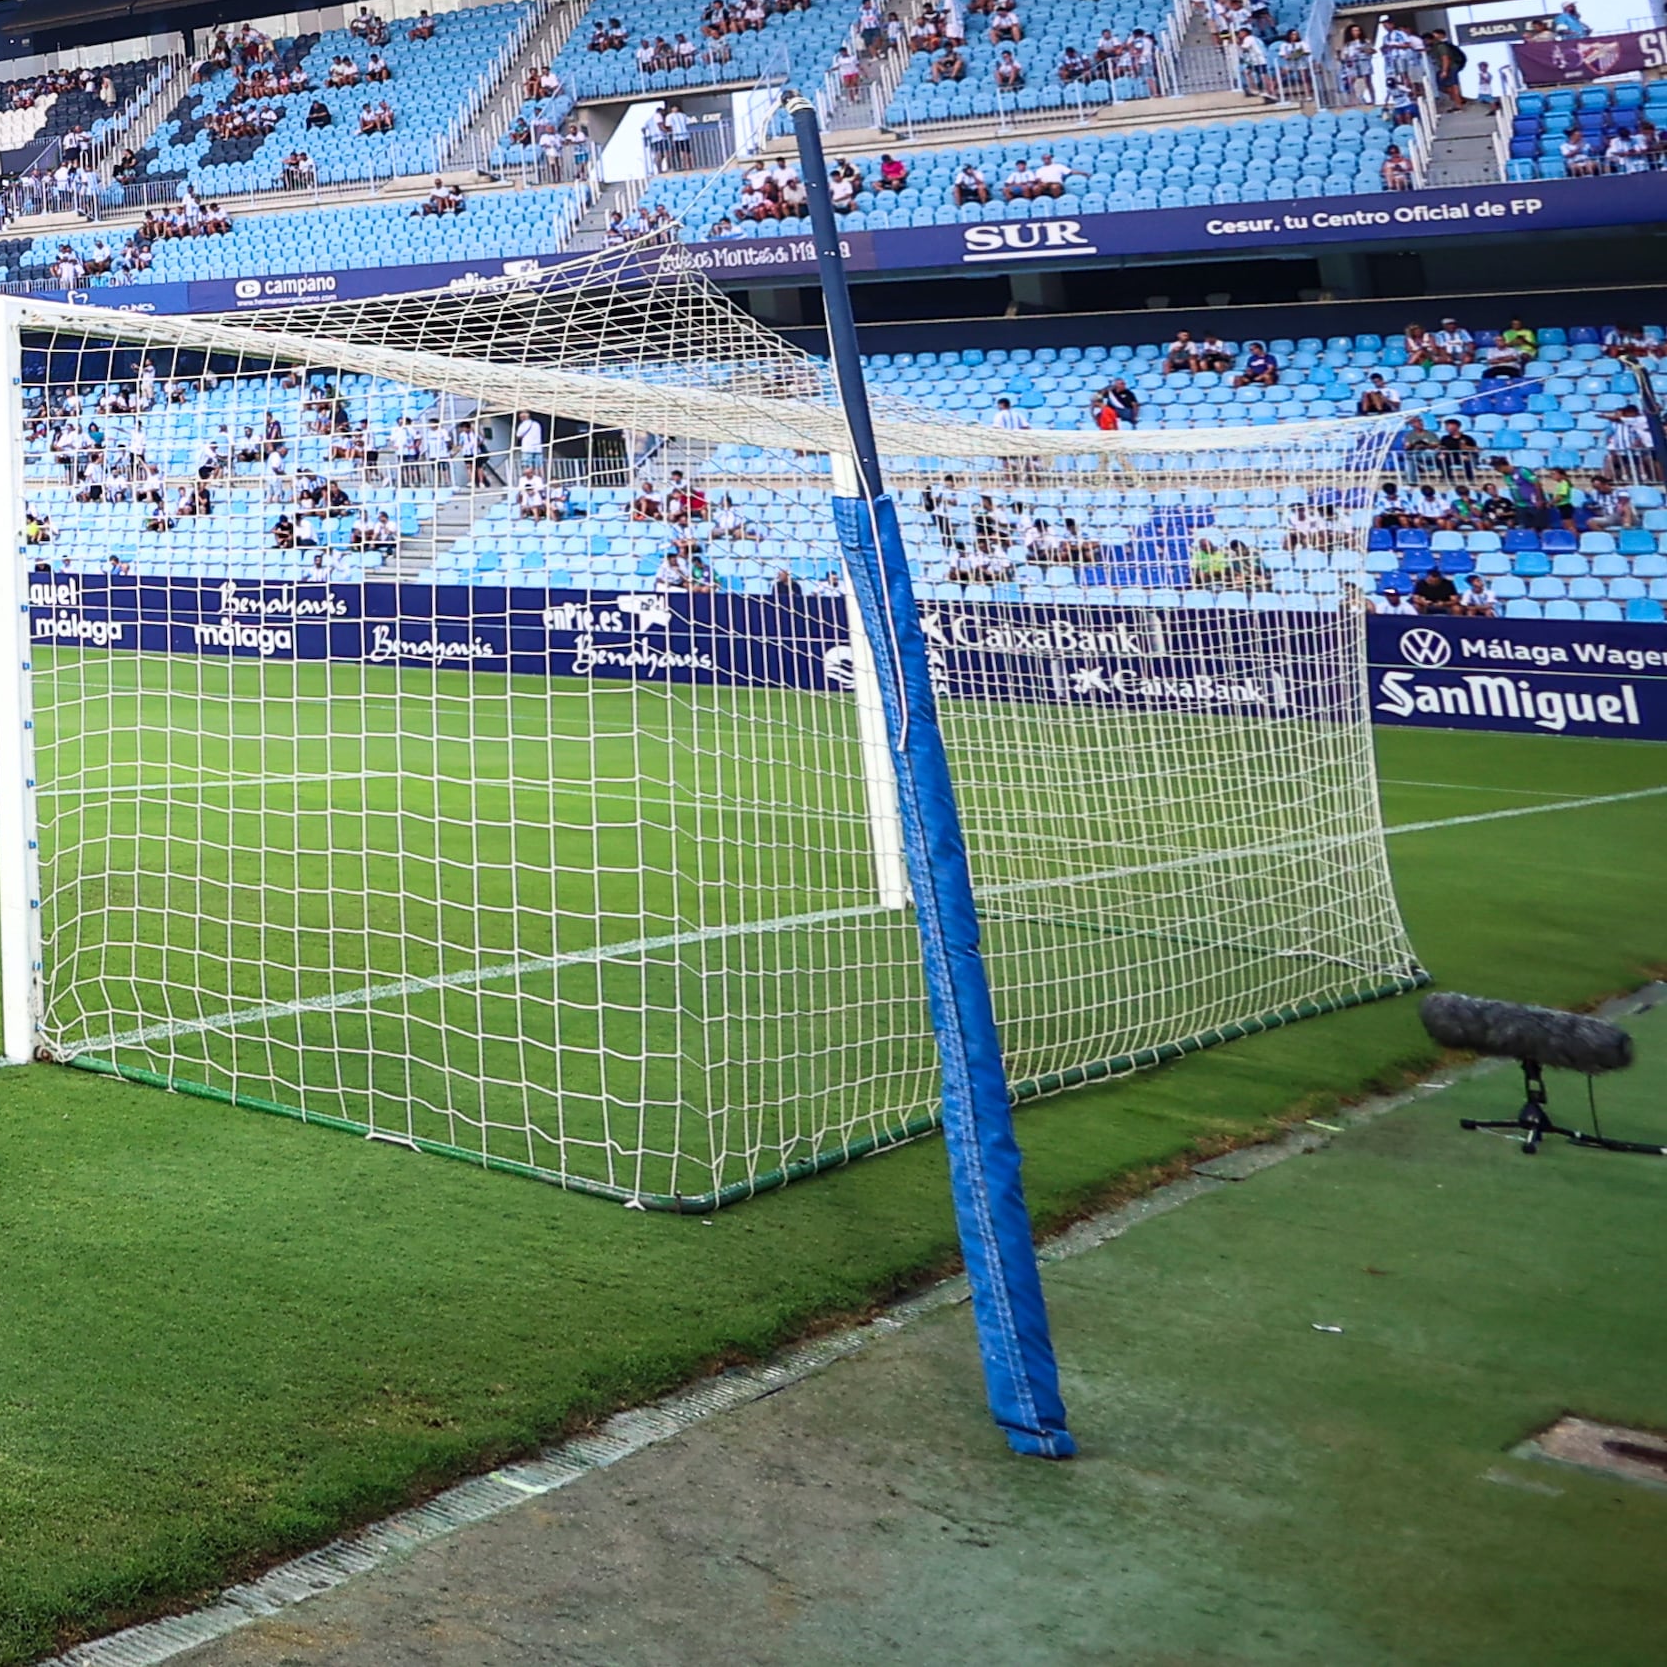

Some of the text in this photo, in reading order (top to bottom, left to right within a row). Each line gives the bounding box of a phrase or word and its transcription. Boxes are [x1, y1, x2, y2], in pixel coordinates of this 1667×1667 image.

[1469, 23, 1517, 37] SALIDA
[1206, 197, 1543, 237] Cesur, tu Centro Oficial de FP
[964, 220, 1089, 253] SUR
[264, 275, 337, 297] campano
[35, 611, 123, 644] málaga
[194, 620, 293, 654] málaga
[952, 614, 1139, 656] CaixaBank
[1460, 638, 1569, 667] Málaga
[1113, 668, 1267, 703] CaixaBank
[1375, 670, 1641, 731] SanMiguel
